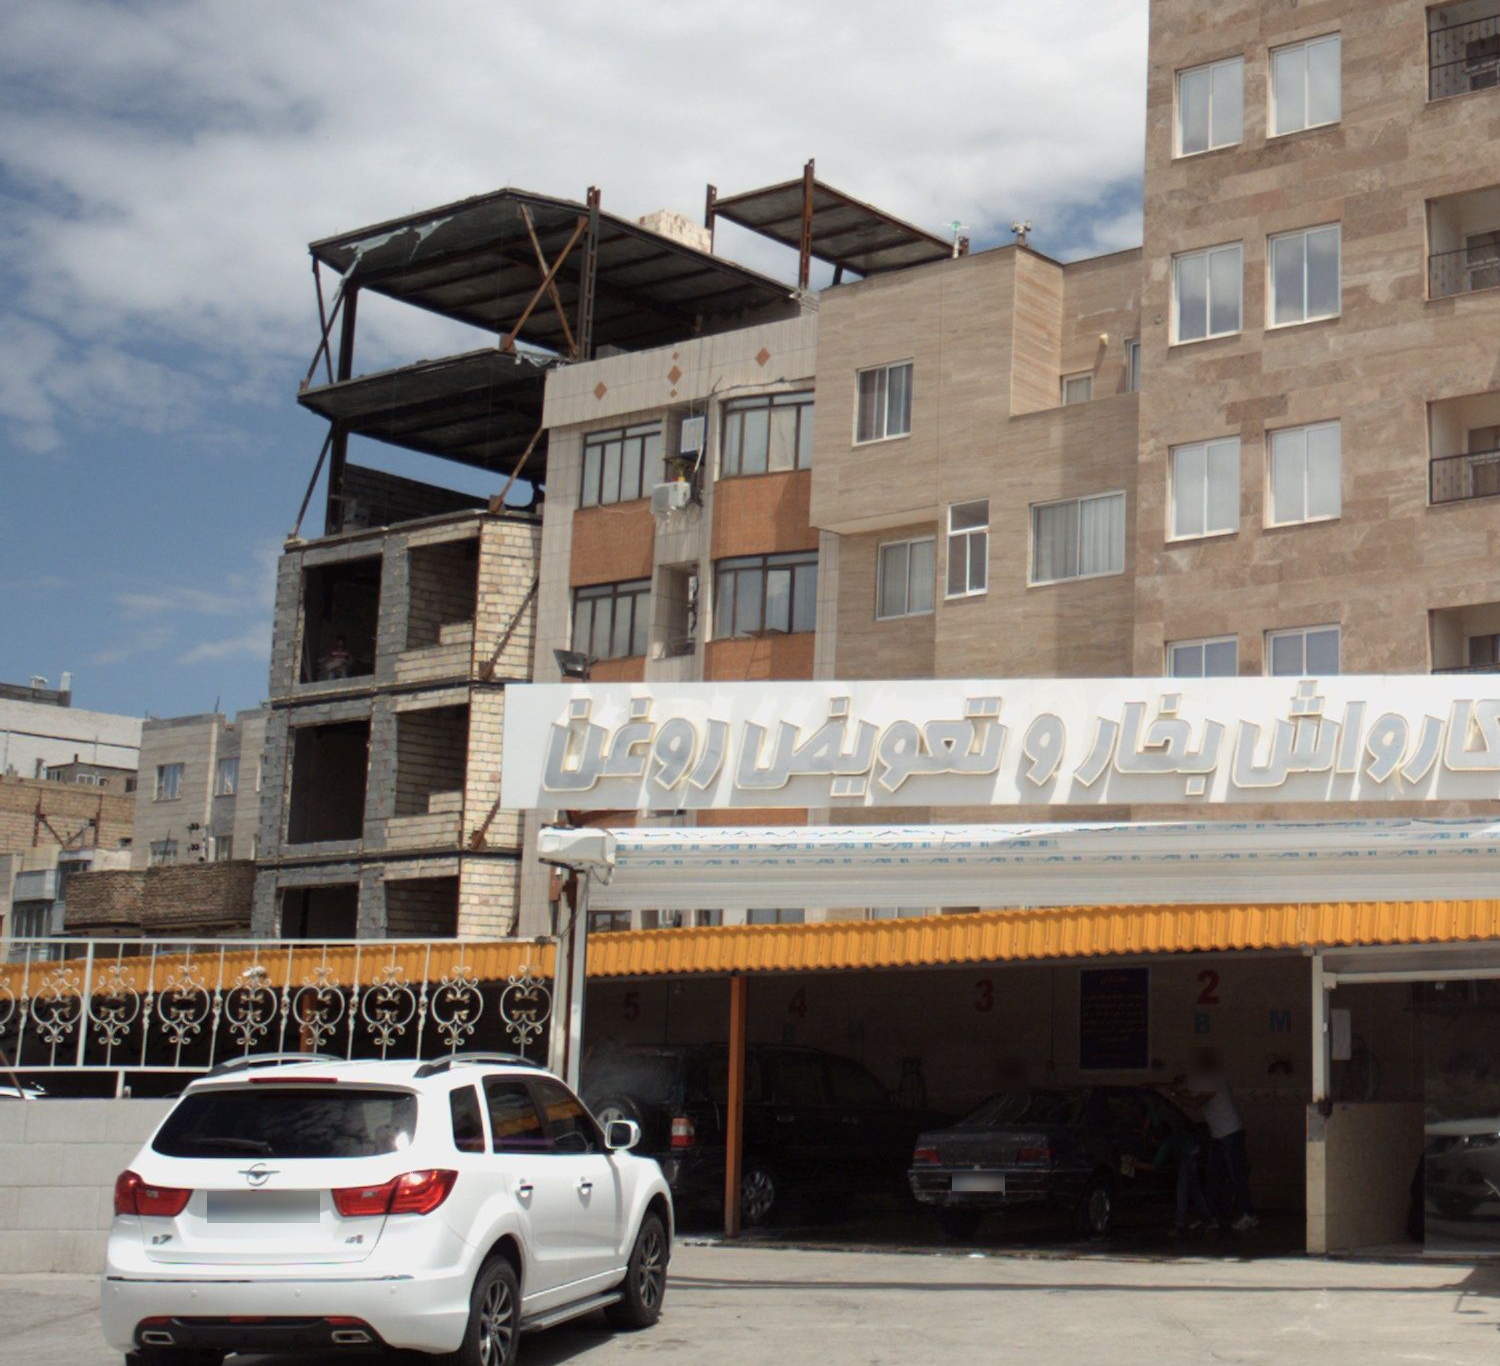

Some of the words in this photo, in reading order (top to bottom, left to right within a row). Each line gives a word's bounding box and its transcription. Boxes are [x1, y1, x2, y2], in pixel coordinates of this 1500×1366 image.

[544, 697, 730, 791] روغن
[734, 696, 1007, 797] تعویض
[1022, 712, 1066, 786] و
[1073, 693, 1226, 795] بخار
[619, 991, 641, 1022] 5
[788, 986, 808, 1018] 4
[973, 979, 995, 1012] 3
[1197, 969, 1221, 1005] 2
